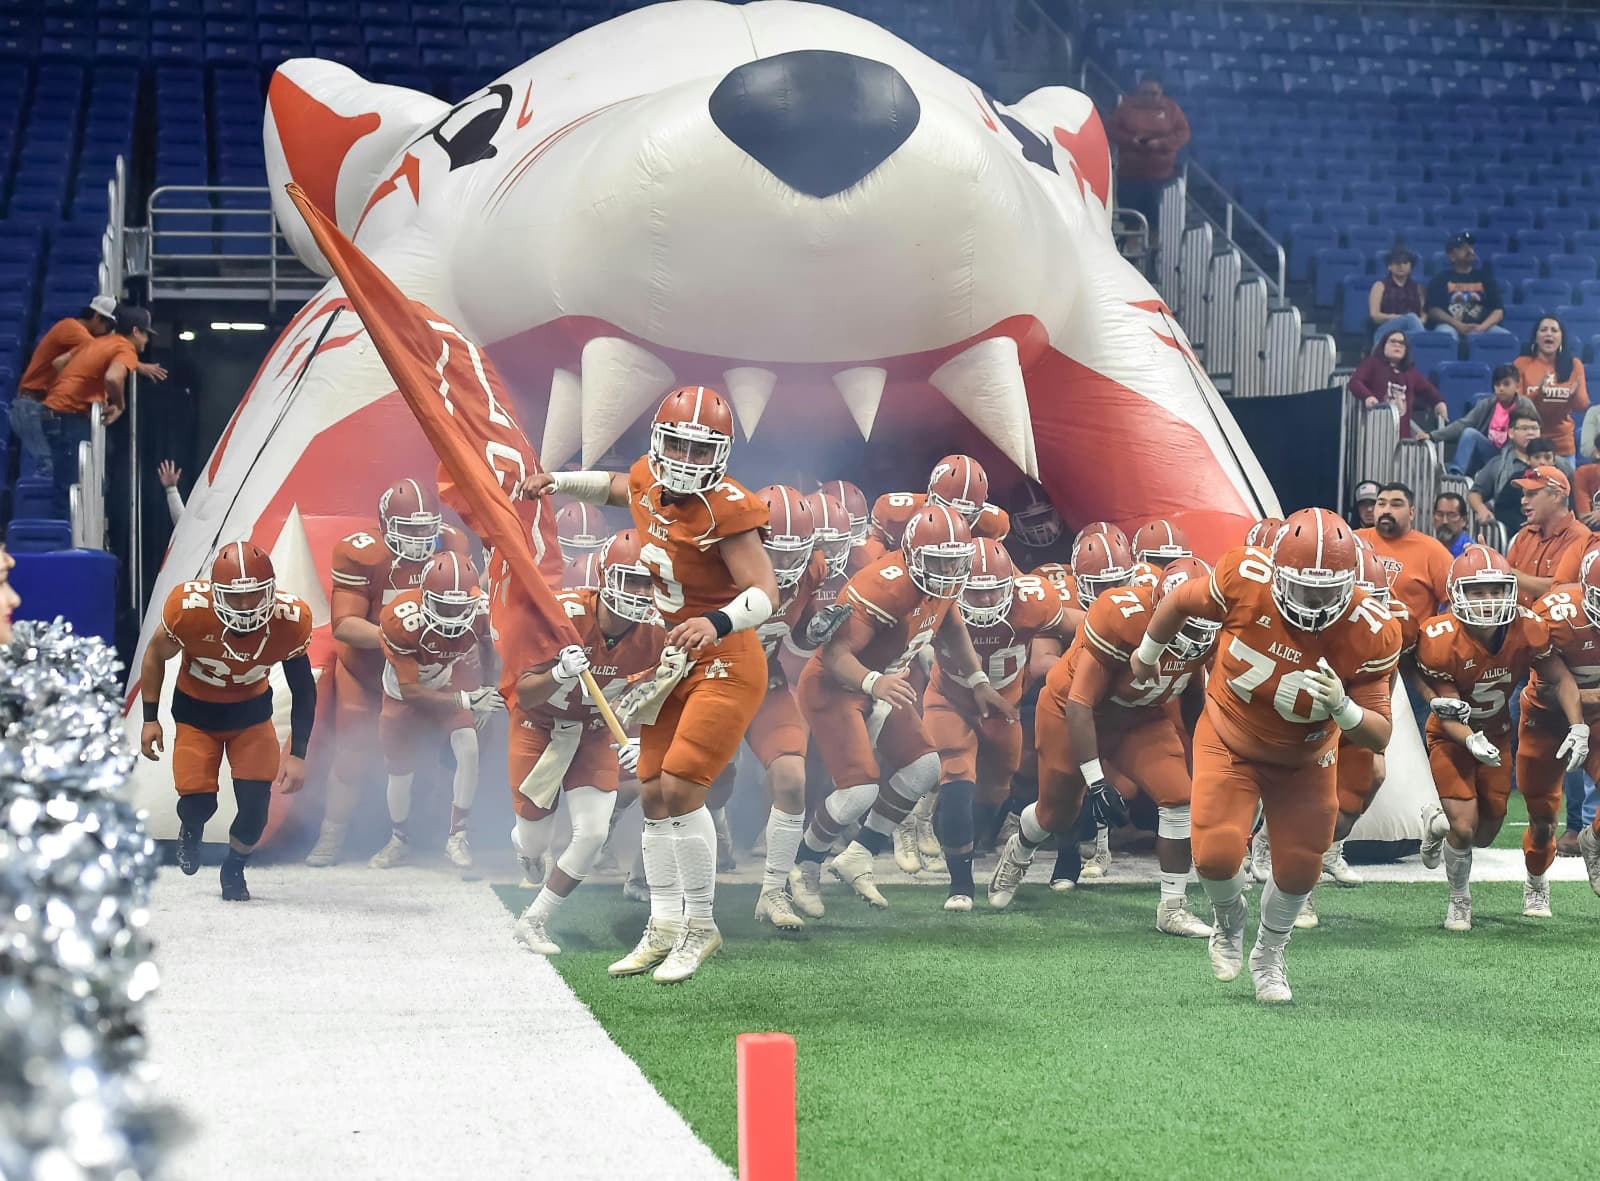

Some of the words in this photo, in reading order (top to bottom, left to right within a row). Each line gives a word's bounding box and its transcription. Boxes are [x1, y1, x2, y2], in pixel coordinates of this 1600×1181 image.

[648, 521, 669, 541] ALICE
[640, 543, 685, 613] 3
[880, 565, 903, 580] 8
[182, 581, 210, 609] 24
[814, 590, 837, 601] LICE
[1014, 576, 1046, 602] 30
[1110, 590, 1145, 618] 71
[1348, 598, 1392, 634] 70
[1542, 592, 1577, 621] 26
[1426, 620, 1454, 638] 5
[1267, 641, 1303, 665] ALICE
[590, 665, 618, 676] ALICE
[1226, 635, 1333, 724] 70
[1482, 667, 1508, 679] ALICE
[1470, 673, 1512, 719] 5
